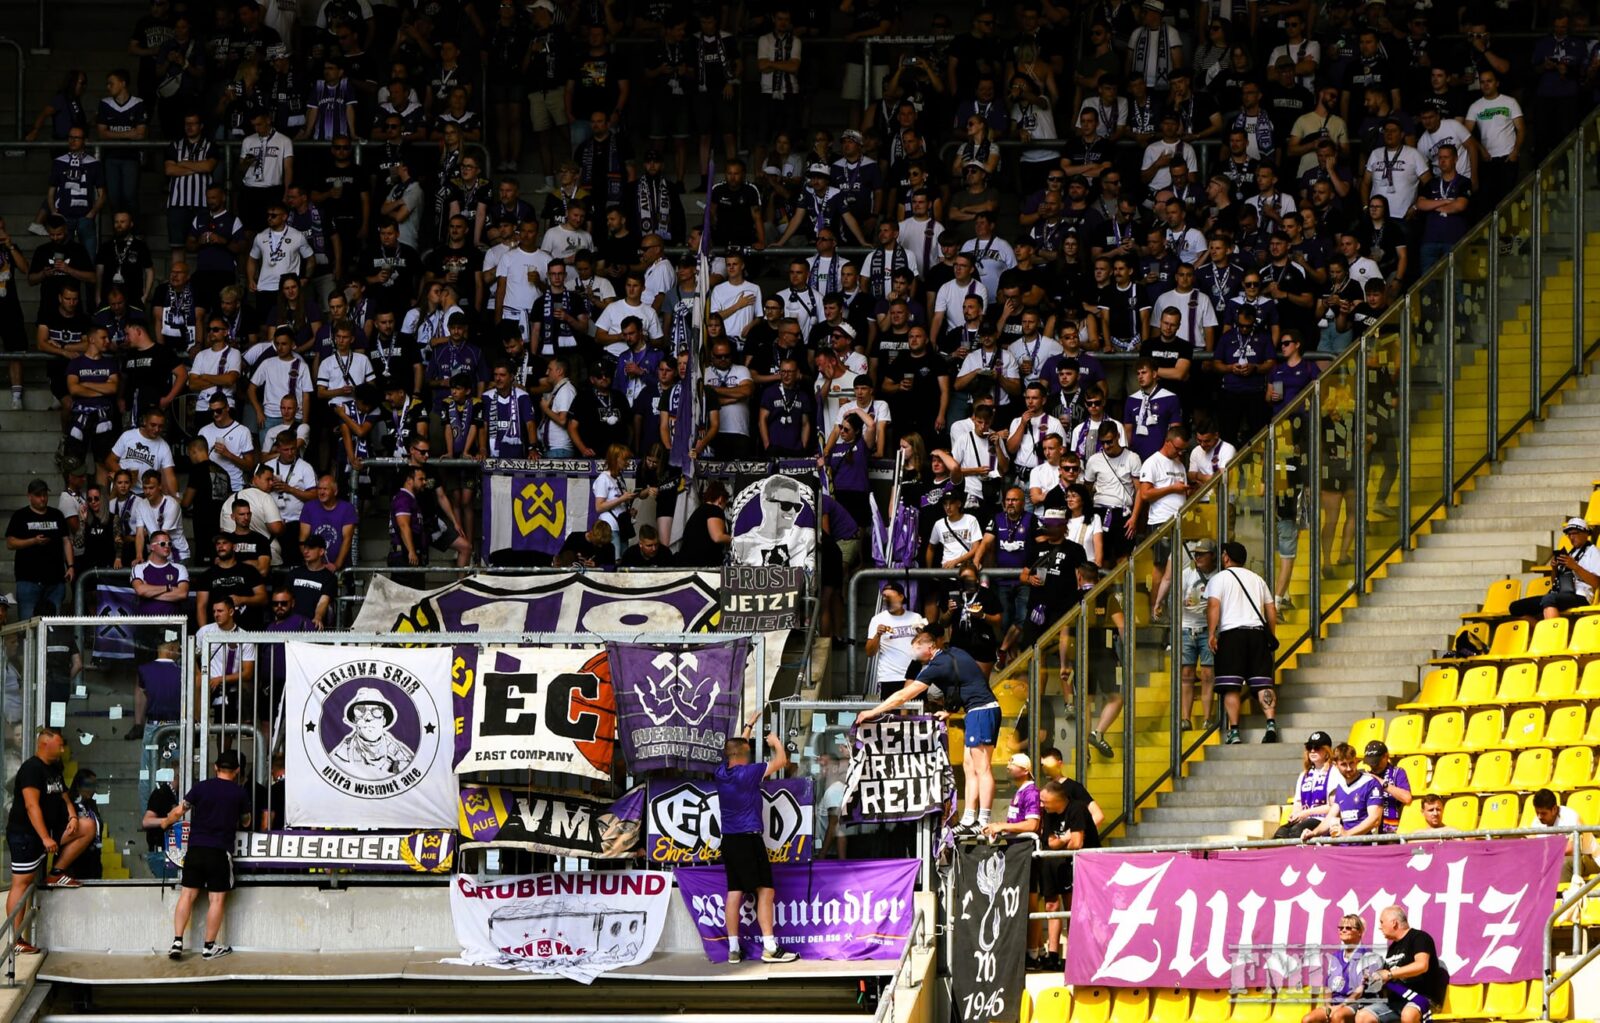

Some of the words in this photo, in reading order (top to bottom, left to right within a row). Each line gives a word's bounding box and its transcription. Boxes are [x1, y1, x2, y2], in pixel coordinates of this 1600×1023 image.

[724, 565, 799, 589] PROST
[724, 590, 798, 612] JETZT
[722, 613, 797, 632] HIER
[479, 673, 600, 742] EC
[475, 750, 507, 762] EAST
[510, 749, 574, 762] COMPANY
[354, 778, 401, 796] wismut
[401, 767, 422, 788] aue
[471, 816, 498, 834] AUE
[515, 797, 595, 844] VM
[421, 852, 437, 860] AUE
[652, 836, 694, 862] Ehre
[458, 874, 666, 900] GRUBENHUND
[692, 888, 906, 928] Wsmutadler
[780, 935, 806, 944] TREUE
[807, 935, 824, 943] DER
[963, 987, 1005, 1021] 1946
